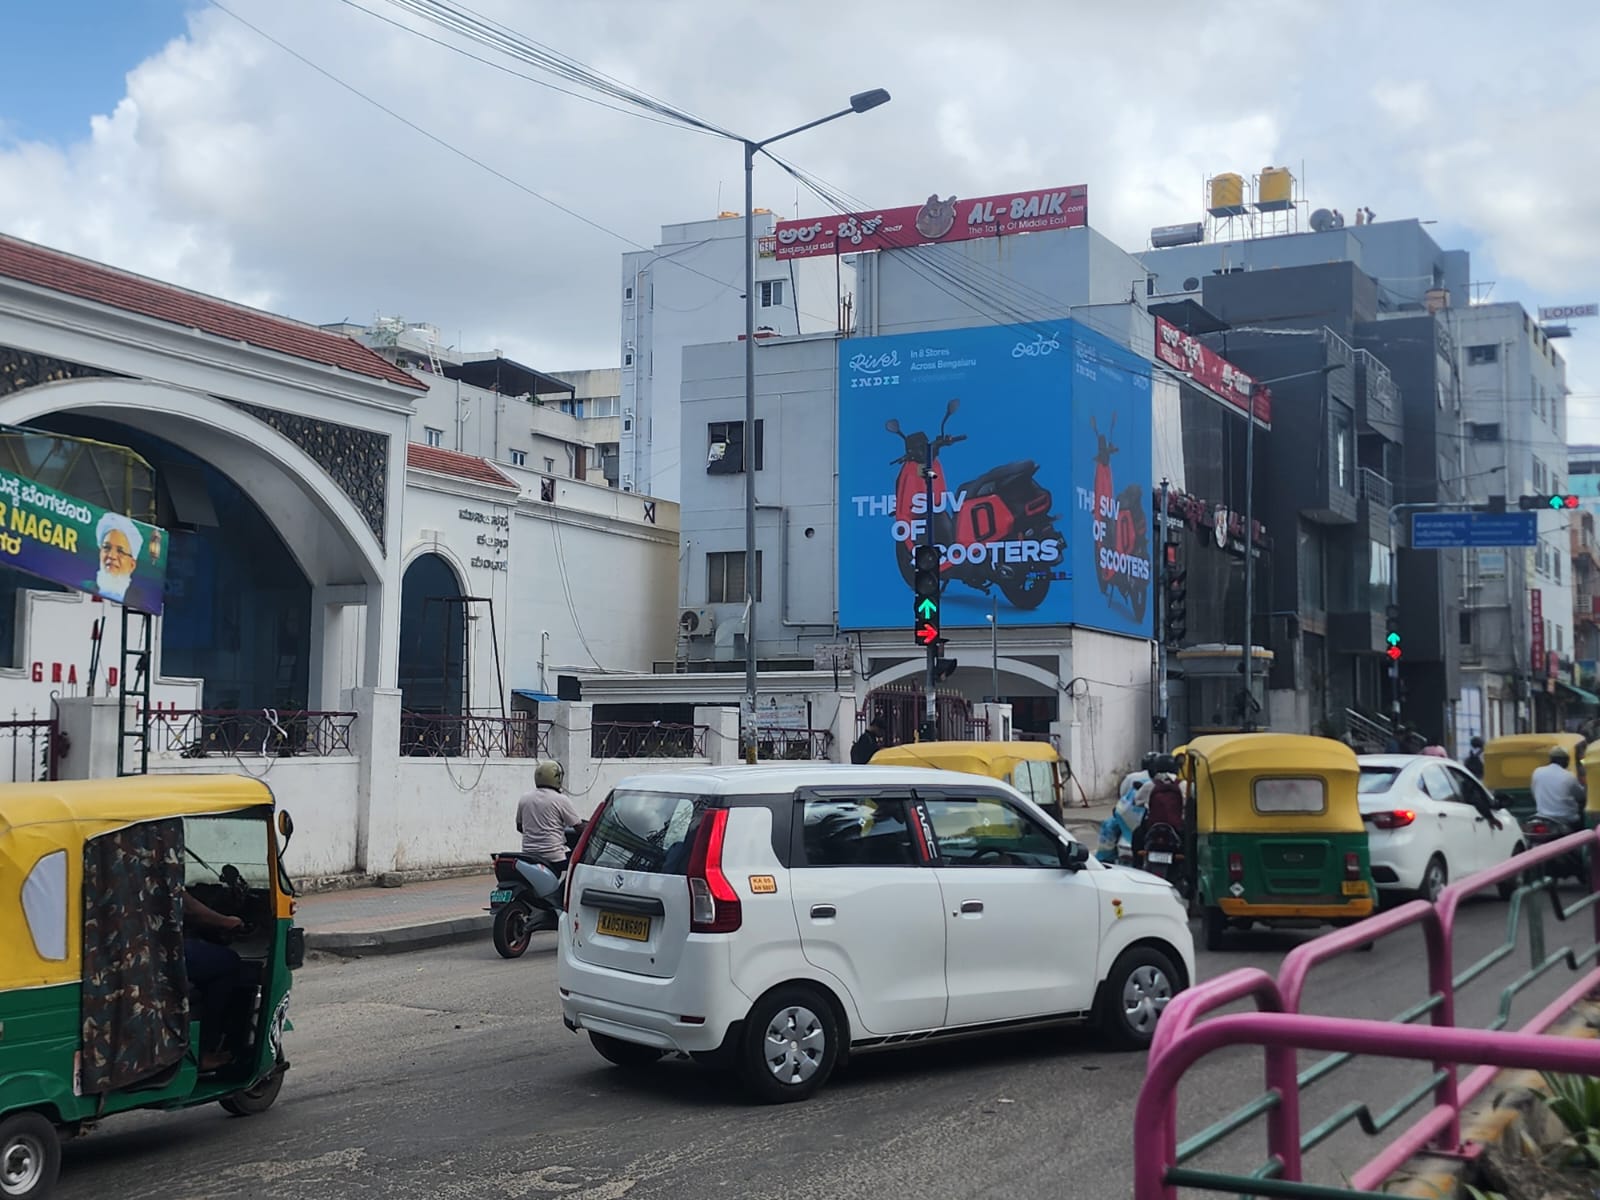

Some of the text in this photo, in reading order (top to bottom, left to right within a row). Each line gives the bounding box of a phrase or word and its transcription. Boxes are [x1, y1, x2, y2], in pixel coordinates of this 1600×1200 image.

[967, 192, 1067, 225] AL-BAIK
[1018, 219, 1048, 229] Middle
[1049, 216, 1067, 225] East
[1543, 304, 1594, 320] LODGE
[849, 350, 902, 374] River
[910, 350, 918, 359] In
[925, 347, 950, 358] Stores
[910, 359, 977, 371] Across Bengaluru
[850, 375, 900, 388] INDIE
[910, 490, 968, 514] SUV
[1099, 494, 1121, 522] SUV
[10, 507, 79, 553] NAGAR
[890, 519, 927, 542] OF
[1092, 519, 1107, 542] OF
[1099, 548, 1151, 580] SCOOTERS
